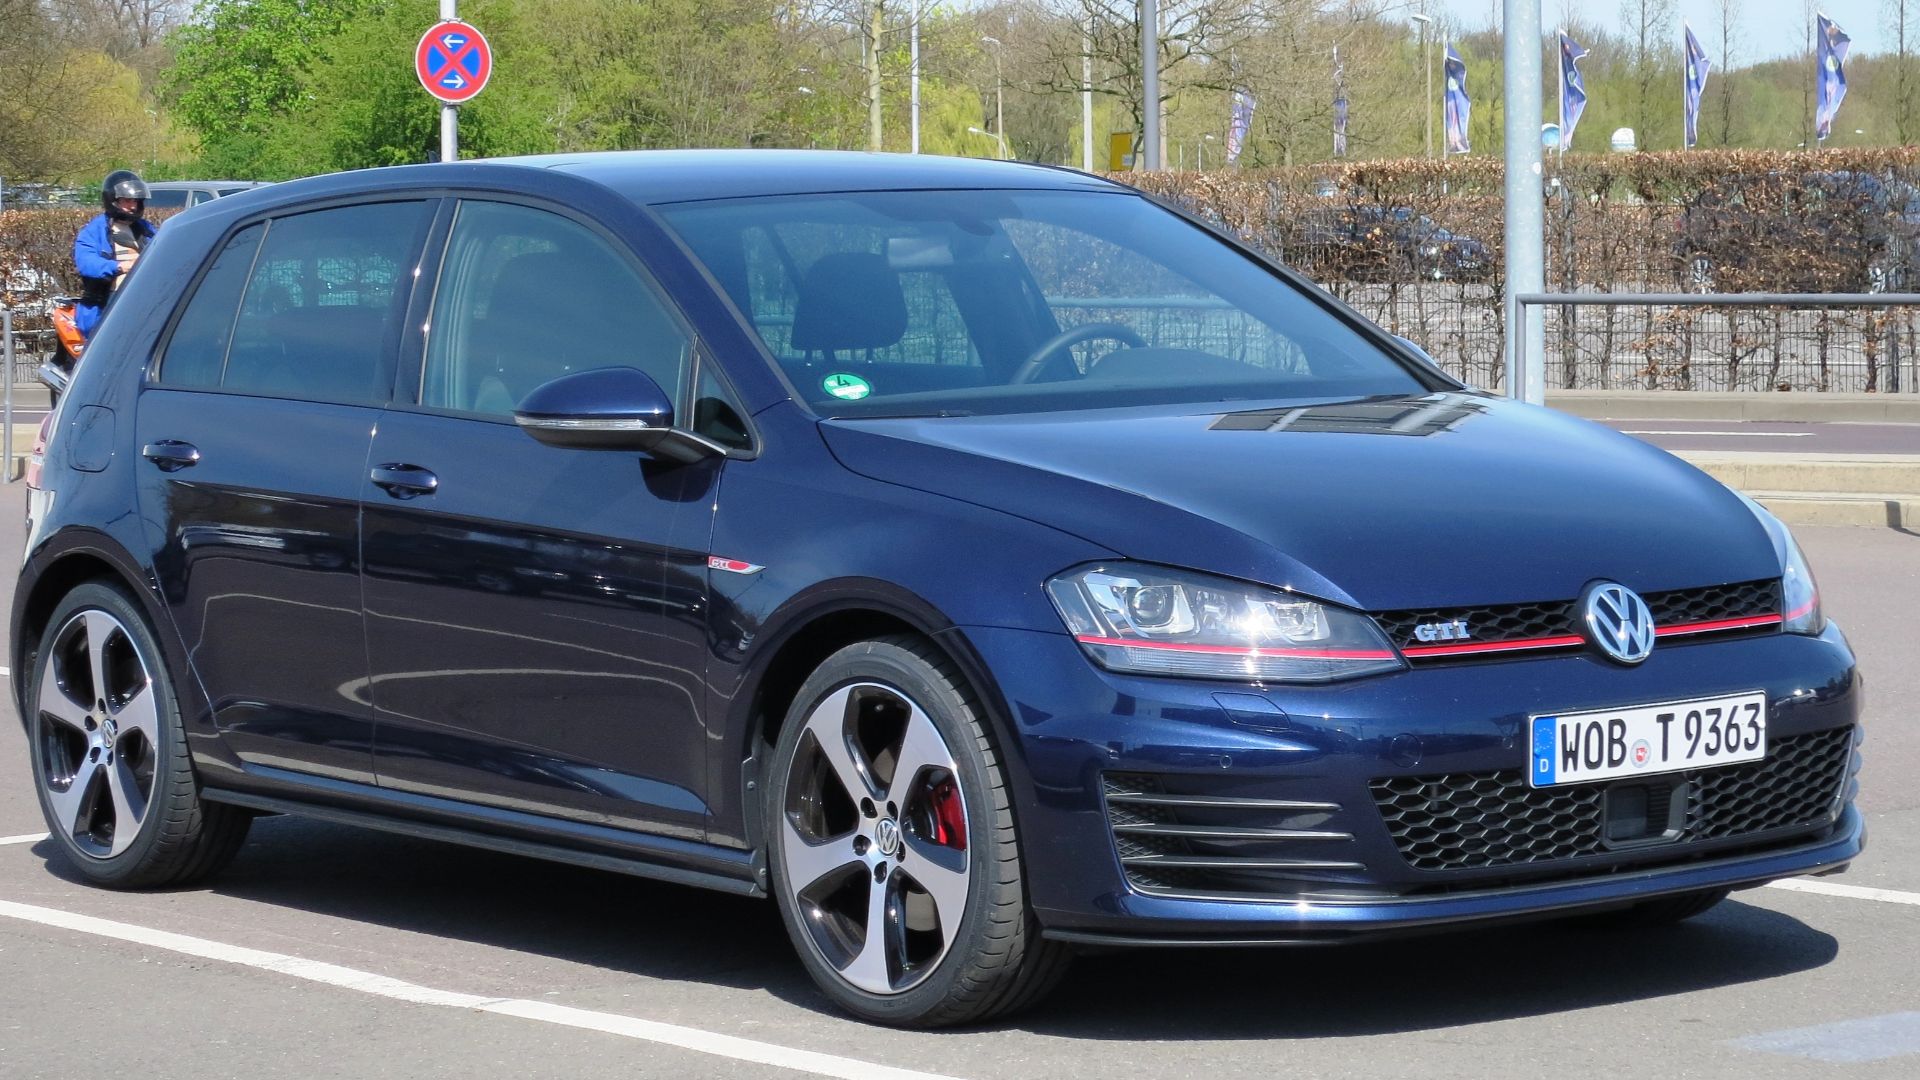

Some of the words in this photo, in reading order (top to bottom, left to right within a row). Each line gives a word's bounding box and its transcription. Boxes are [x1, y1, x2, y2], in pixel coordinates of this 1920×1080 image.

[1414, 621, 1471, 642] GTI
[1588, 584, 1655, 662] VW
[1560, 718, 1627, 773] WOB
[1656, 713, 1675, 762] T
[1684, 702, 1761, 760] 9363
[1539, 758, 1549, 773] D
